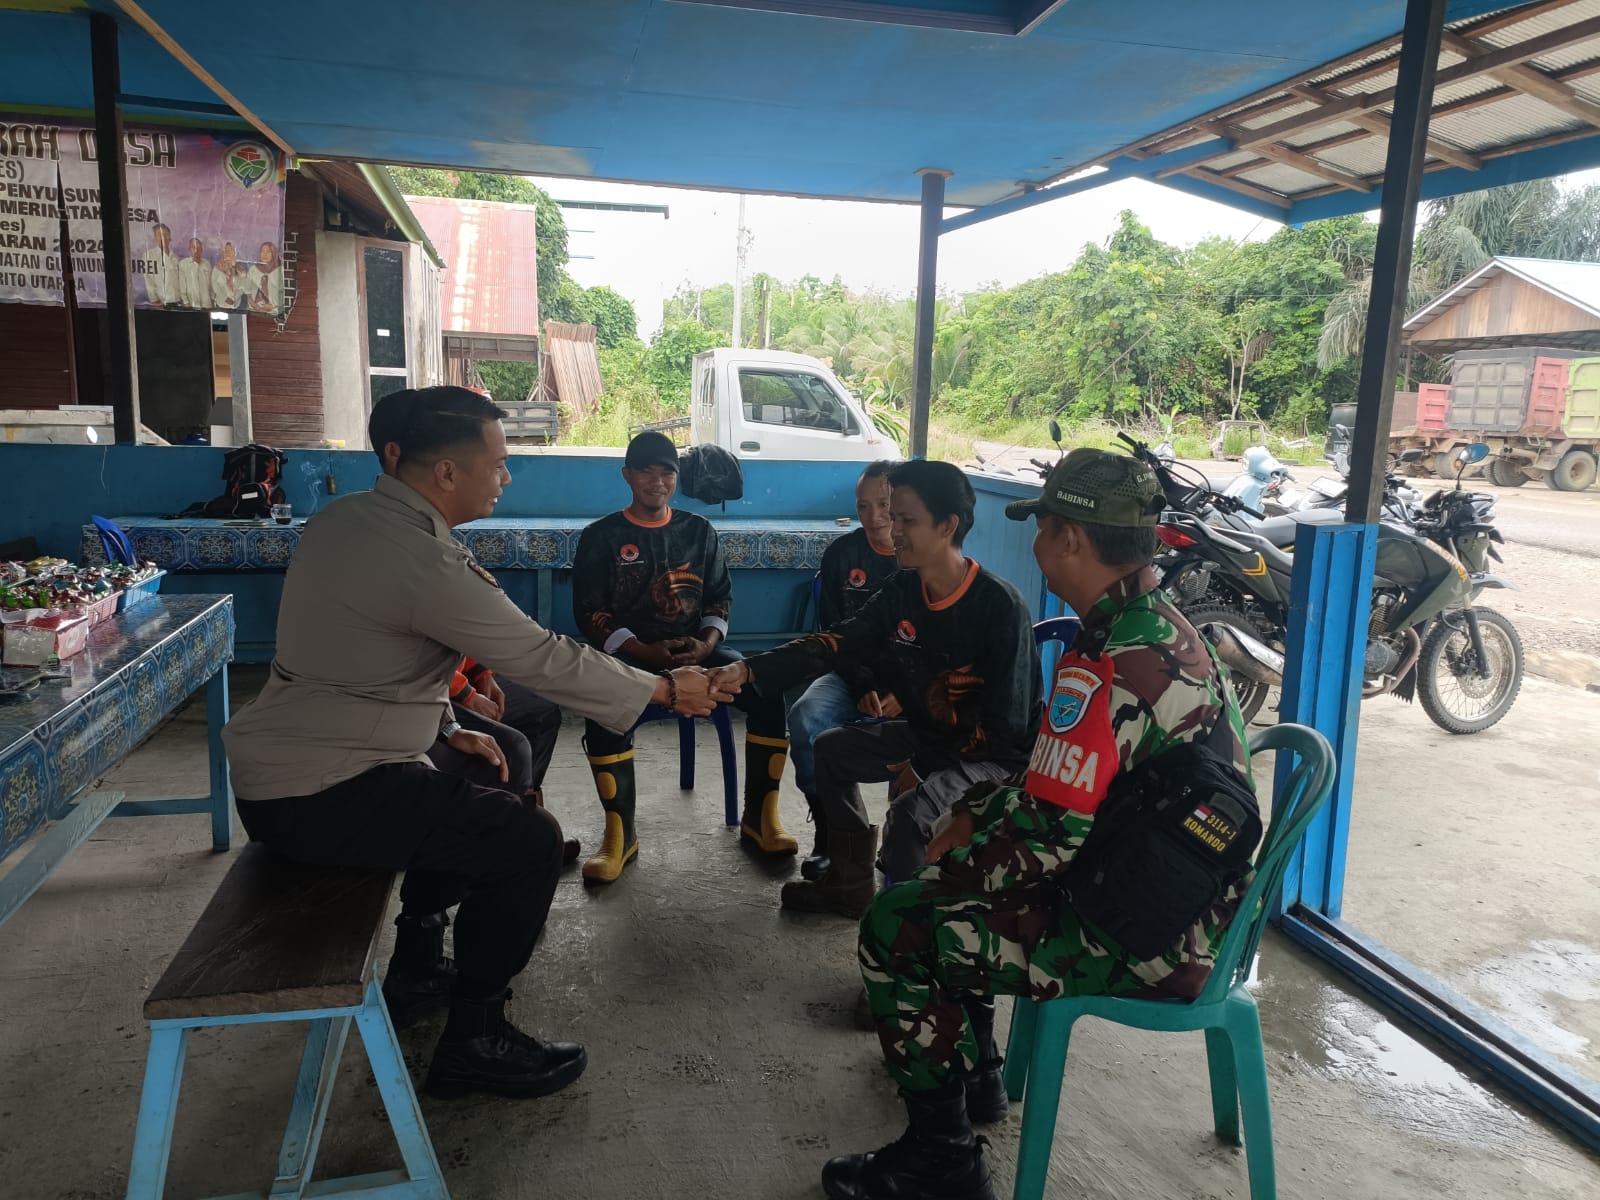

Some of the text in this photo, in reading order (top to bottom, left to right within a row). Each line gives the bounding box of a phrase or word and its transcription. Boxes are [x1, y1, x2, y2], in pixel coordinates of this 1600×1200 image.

[78, 127, 177, 168] DSA
[127, 207, 159, 223] ESA
[1057, 490, 1095, 509] BABINSA
[1183, 816, 1226, 852] KOMANDO
